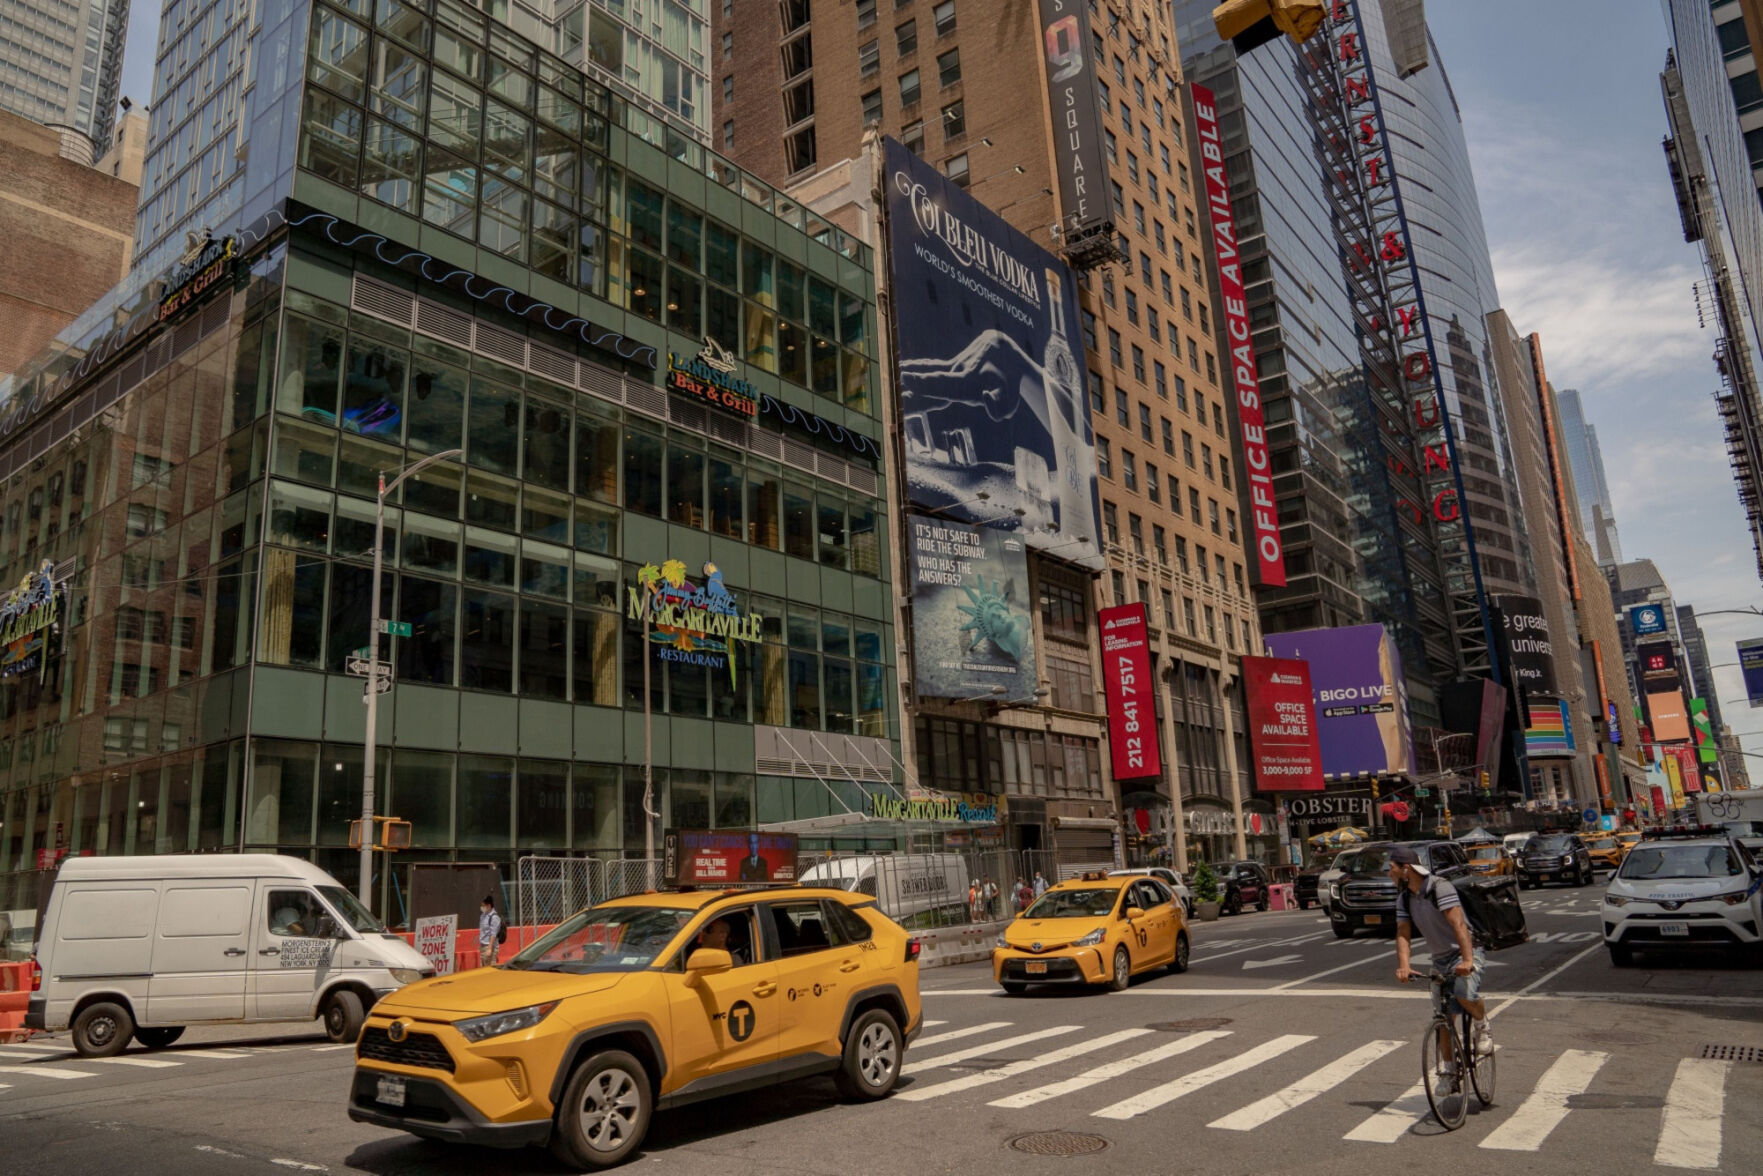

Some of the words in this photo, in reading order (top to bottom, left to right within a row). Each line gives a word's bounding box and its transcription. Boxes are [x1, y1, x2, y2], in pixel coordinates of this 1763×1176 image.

[1065, 87, 1088, 219] SQUARE
[1196, 101, 1242, 287] AVAILABLE
[944, 211, 988, 268] BLEU
[989, 241, 1040, 303] VODKA
[914, 243, 956, 280] WORLD'S
[957, 270, 1004, 310] SMOOTHEST
[1005, 300, 1034, 329] VODKA
[1226, 296, 1259, 410] SPACE
[673, 352, 758, 400] LANDSHARK
[1380, 231, 1406, 261] &
[1397, 305, 1459, 522] YOUNG
[675, 371, 703, 395] Bar
[706, 387, 720, 403] &
[721, 391, 757, 417] Grill
[1244, 424, 1279, 563] OFFICE
[916, 524, 931, 538] IT'S
[932, 527, 948, 541] NOT
[949, 530, 969, 545] SAFE
[970, 533, 980, 546] TO
[917, 537, 935, 552] RIDE
[937, 540, 952, 555] THE
[953, 543, 987, 560] SUBWAY.
[917, 555, 937, 570] WHO
[939, 557, 956, 573] HAS
[957, 561, 972, 575] THE
[918, 571, 962, 587] ANSWERS?
[1104, 638, 1128, 646] LEASING
[1105, 641, 1143, 651] INFORMATION
[660, 647, 724, 669] RESTAURANT
[1119, 657, 1136, 696] 7517
[1320, 688, 1358, 701] BIGO
[1361, 685, 1393, 698] LIVE
[1124, 701, 1139, 733] 841
[1274, 703, 1306, 714] OFFICE
[1280, 714, 1307, 725] SPACE
[1262, 724, 1308, 736] AVAILABLE
[1127, 737, 1143, 768] 212
[873, 793, 959, 821] MARGARITAVILLE
[422, 924, 449, 939] WORK
[281, 946, 299, 954] FINEST
[422, 941, 446, 956] ZONE
[713, 1011, 727, 1021] NYC
